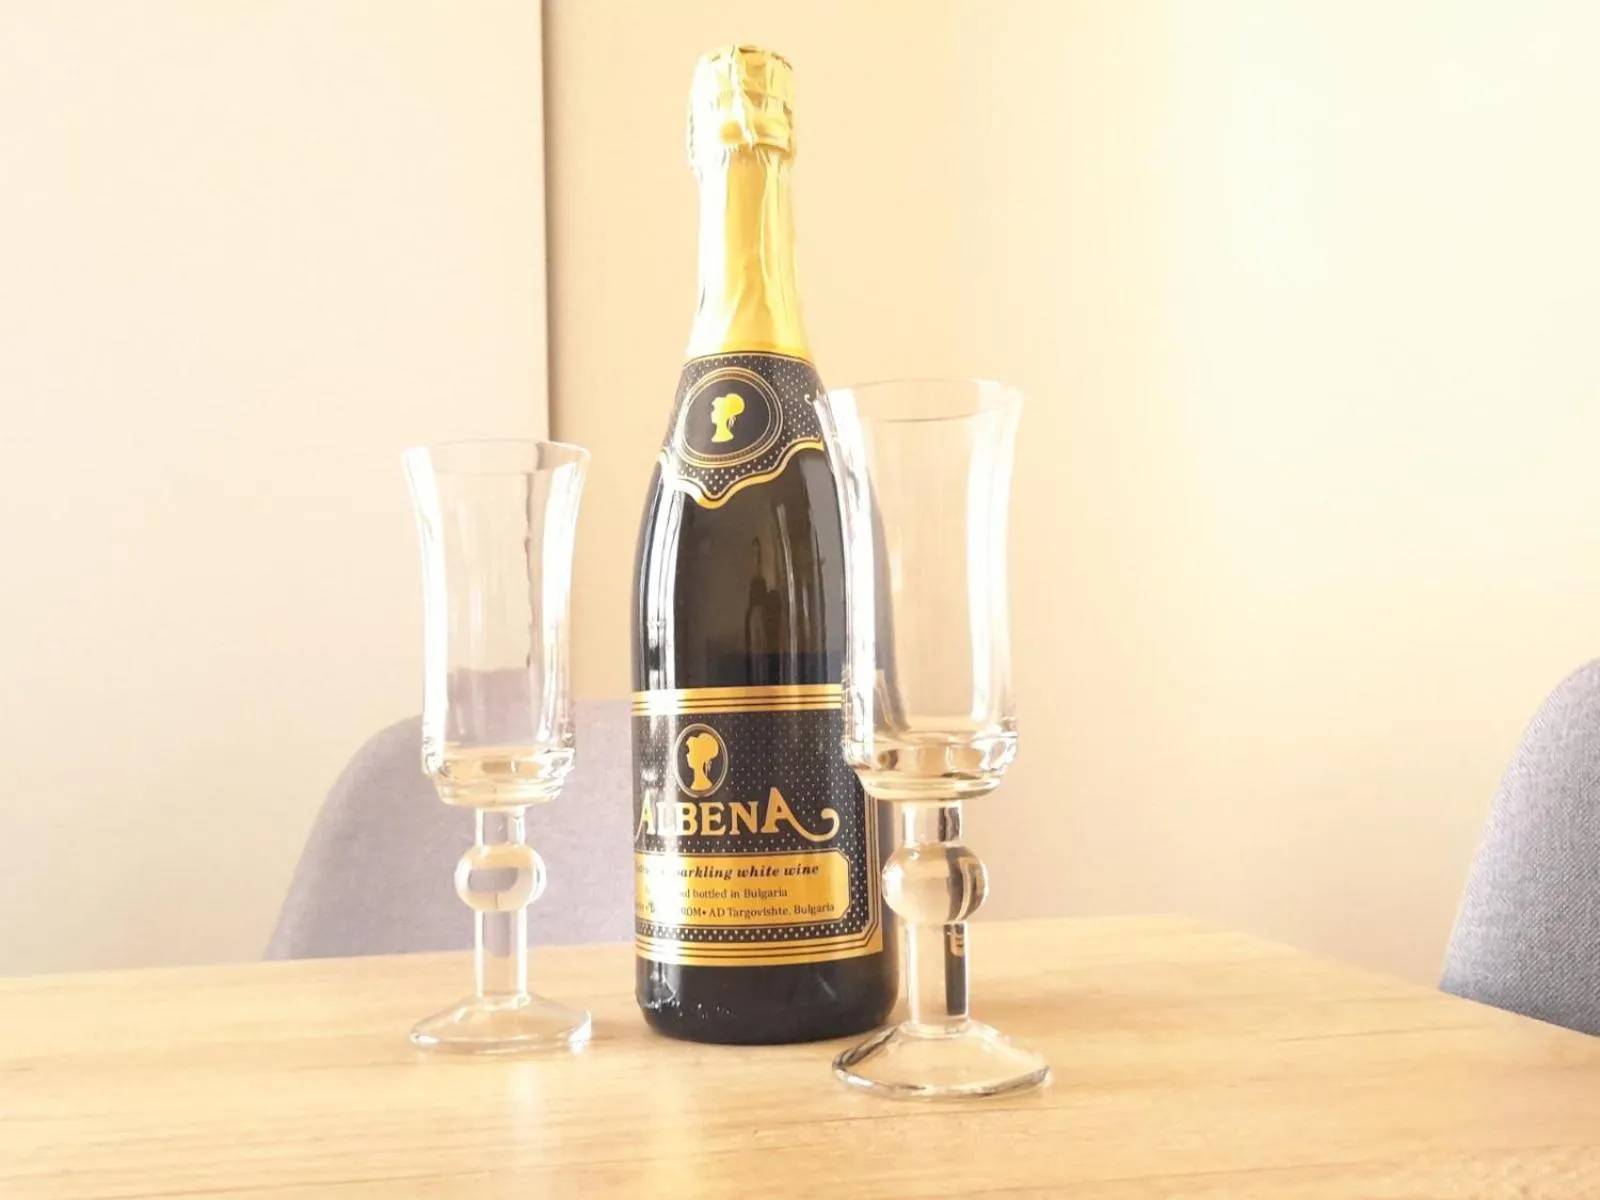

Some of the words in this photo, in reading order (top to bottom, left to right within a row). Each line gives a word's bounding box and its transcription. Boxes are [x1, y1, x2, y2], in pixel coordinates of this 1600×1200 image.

[634, 786, 840, 842] ALBENA
[737, 865, 779, 878] white
[784, 863, 819, 877] wine
[692, 888, 727, 899] bottled
[730, 888, 740, 898] in
[744, 887, 788, 900] Bulgaria
[709, 907, 725, 918] AD
[793, 901, 835, 916] Bulgaria
